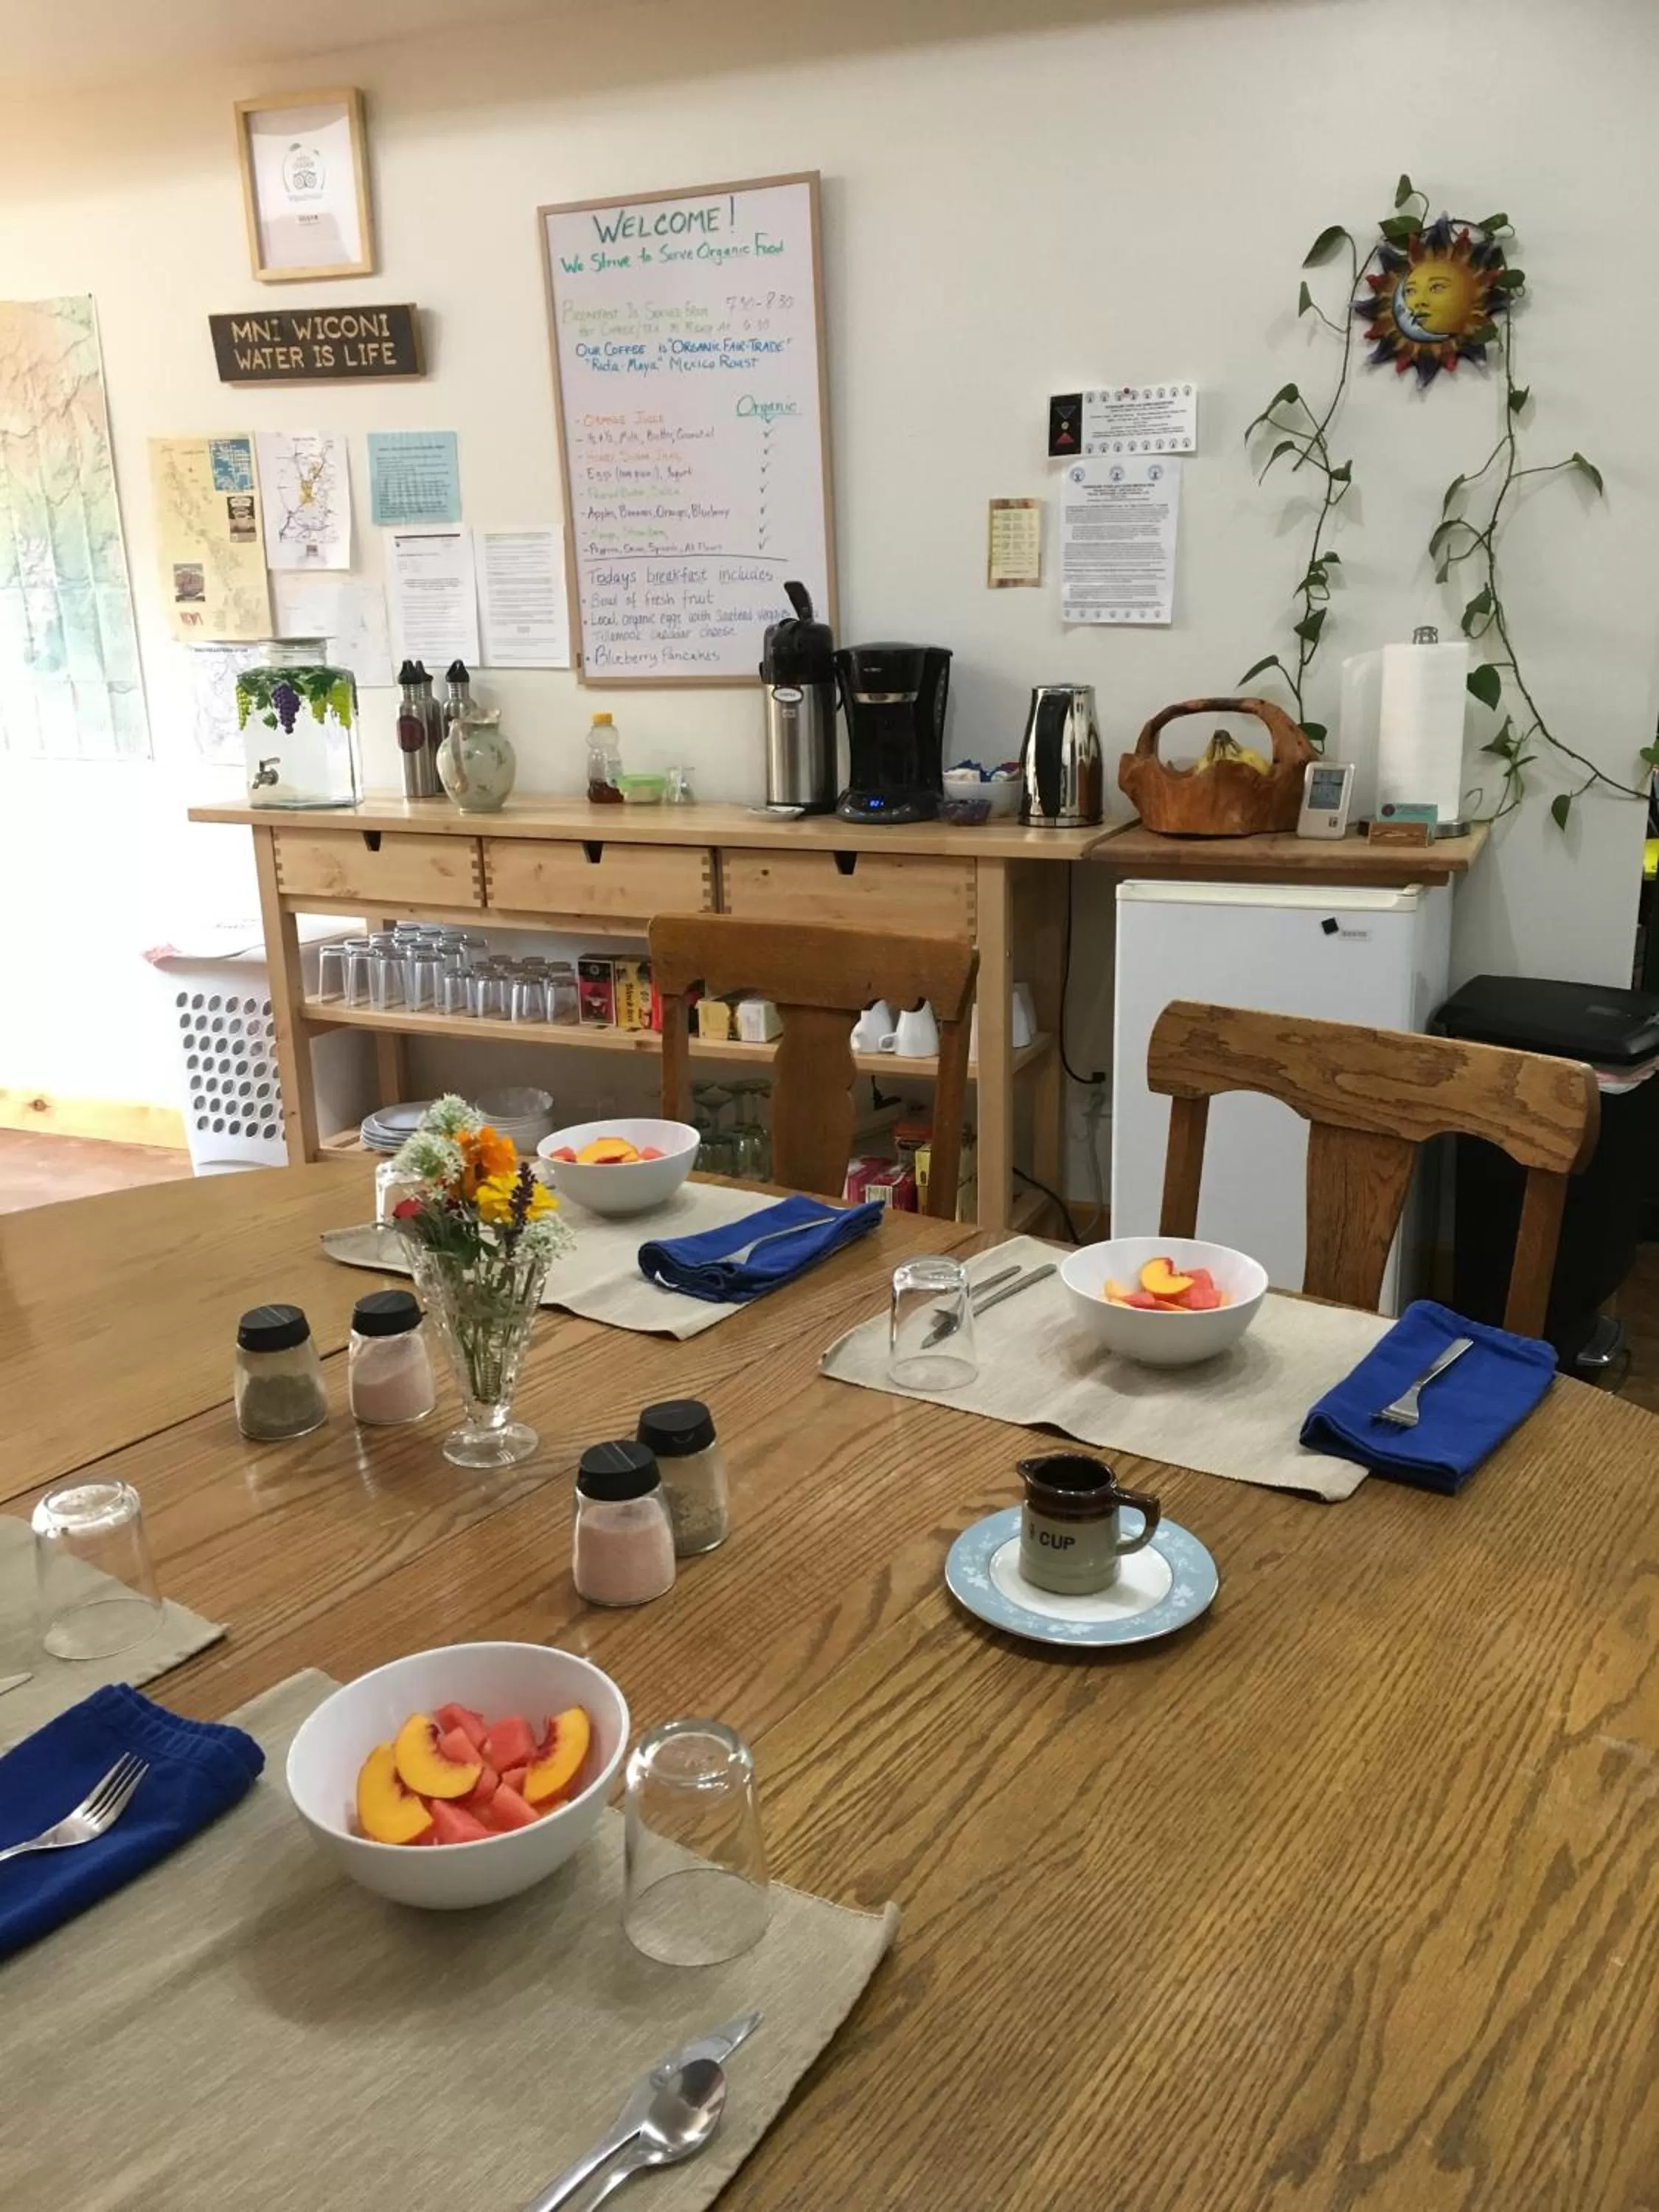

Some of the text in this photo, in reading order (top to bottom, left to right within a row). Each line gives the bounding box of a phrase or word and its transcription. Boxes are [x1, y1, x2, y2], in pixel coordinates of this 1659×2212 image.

[560, 232, 786, 274] We Strive to Serve Organic Food
[292, 313, 390, 340] WICONI
[234, 342, 397, 370] WATER IS LIFE
[737, 395, 798, 417] Organic
[590, 566, 773, 591] Todays breakfast includes
[626, 591, 636, 608] of
[683, 589, 714, 608] fruit
[689, 611, 711, 623] with
[595, 644, 658, 668] Blueberry
[1040, 1531, 1076, 1551] CUP
